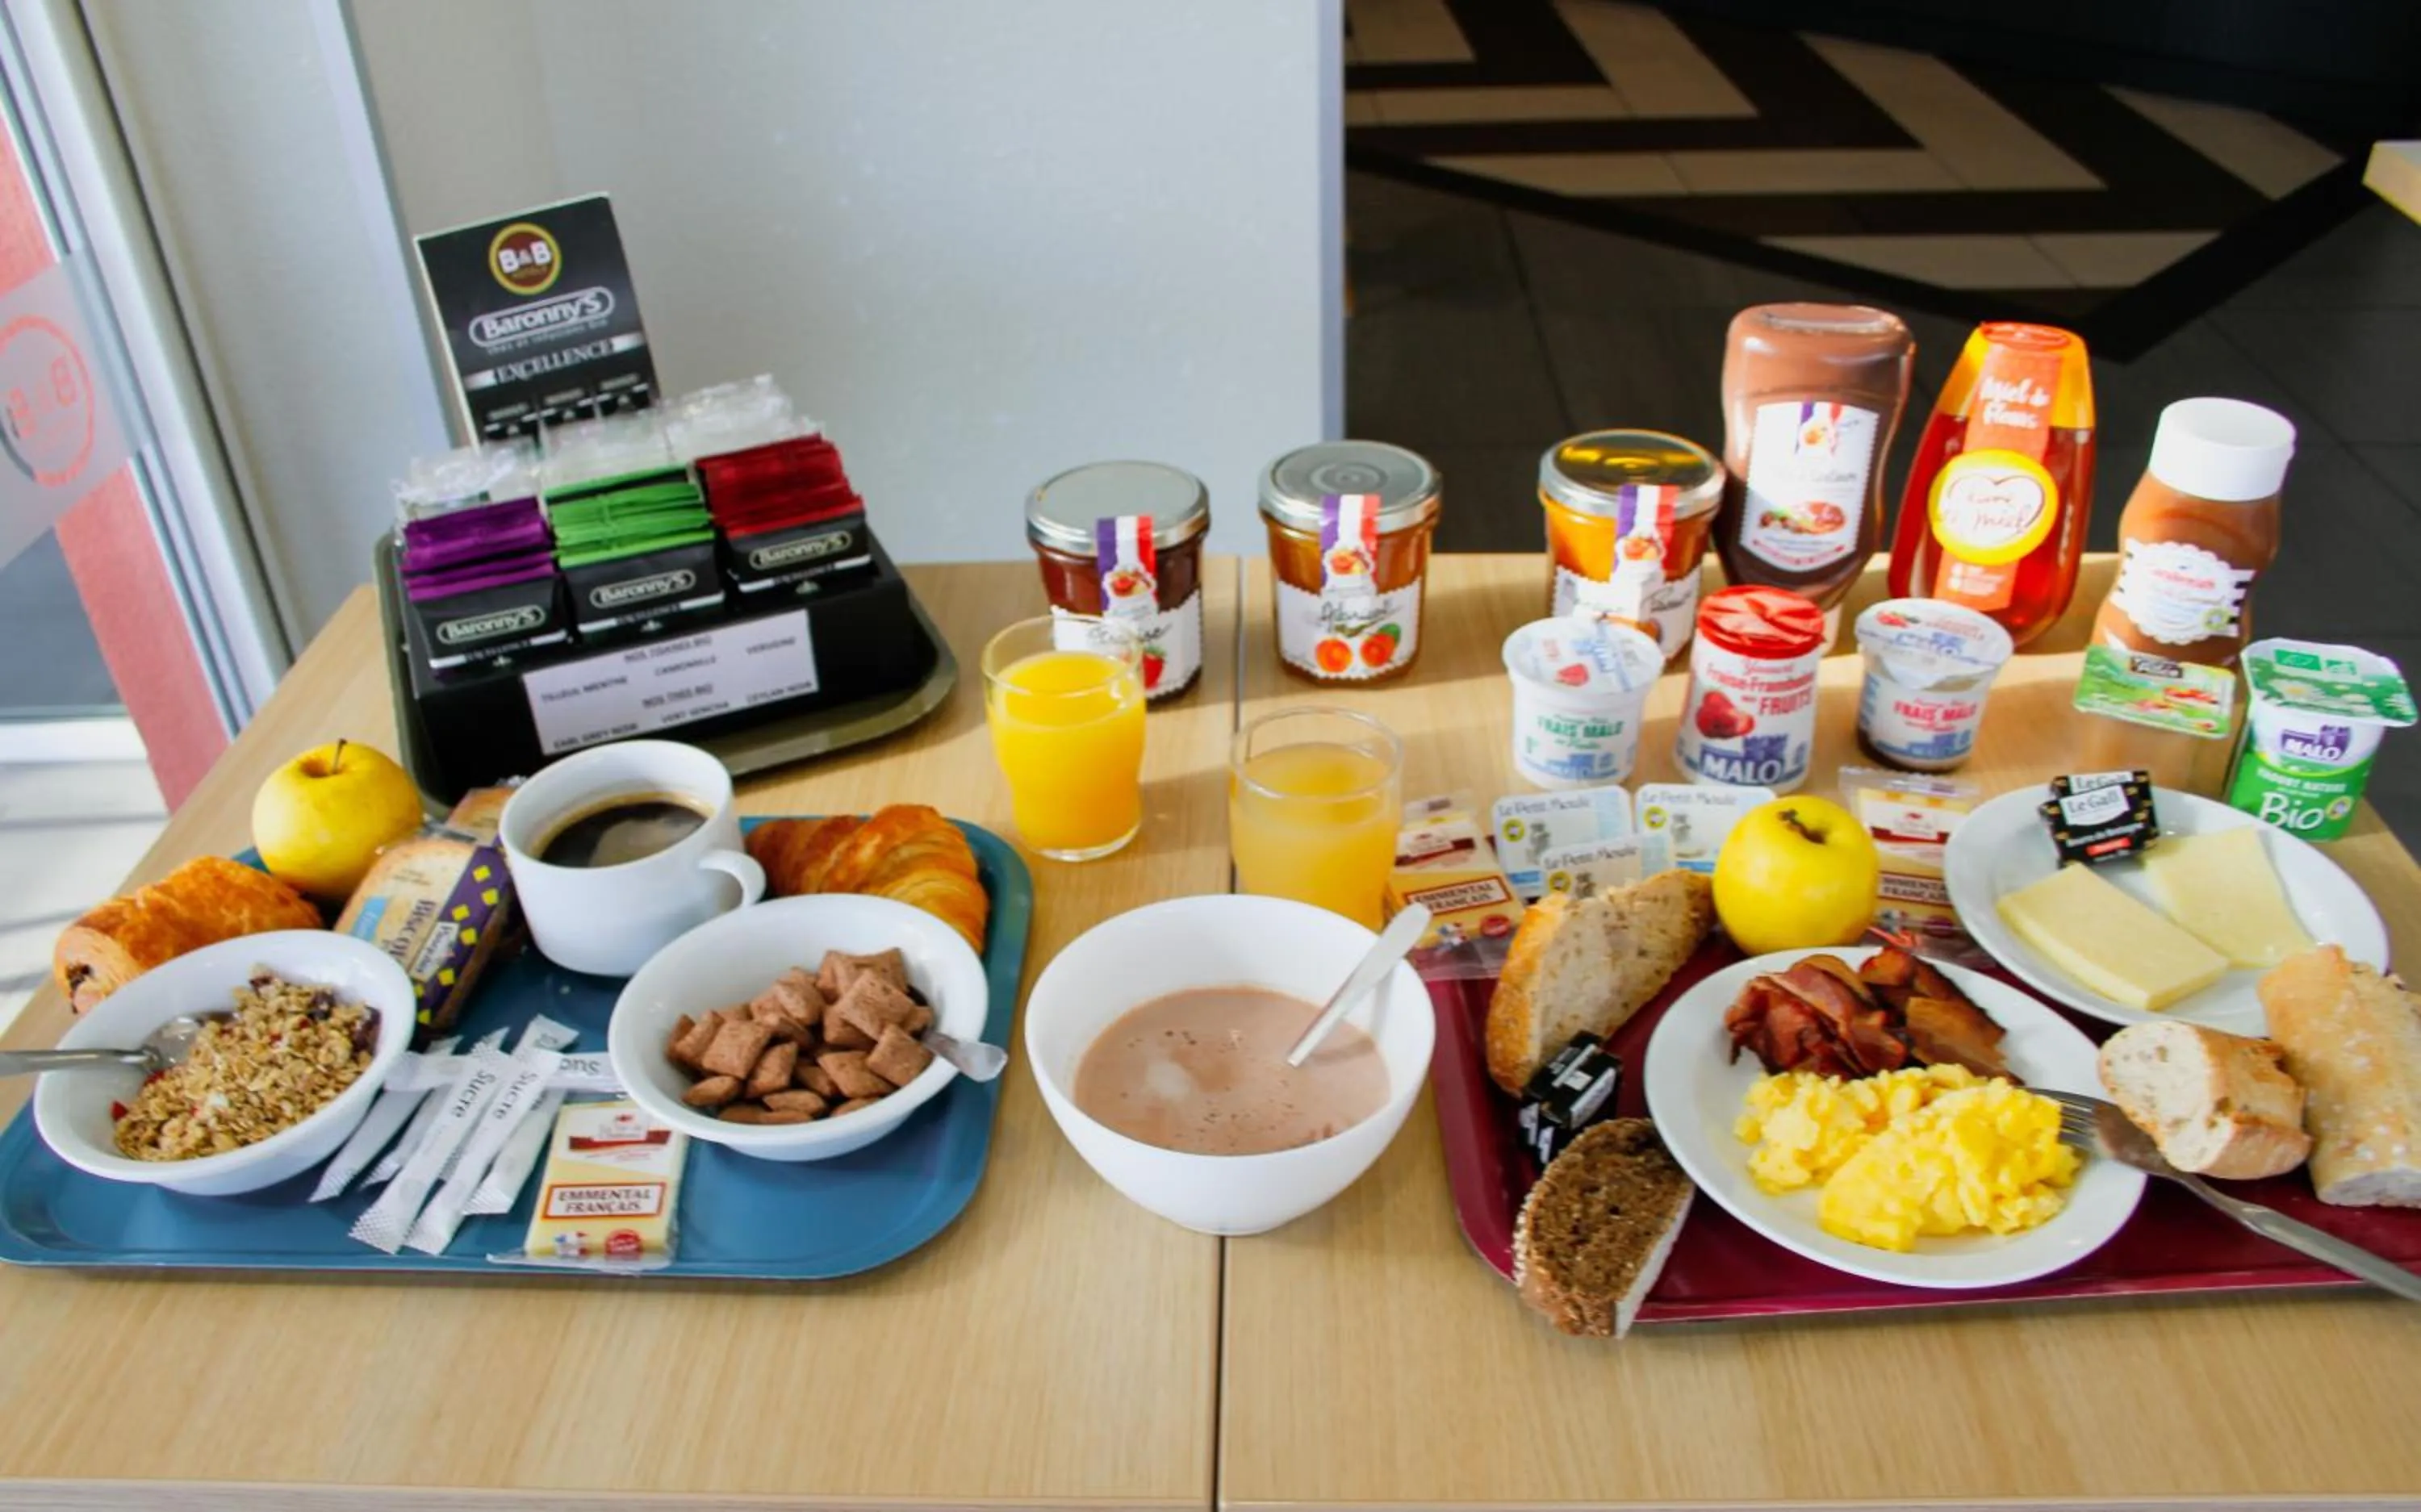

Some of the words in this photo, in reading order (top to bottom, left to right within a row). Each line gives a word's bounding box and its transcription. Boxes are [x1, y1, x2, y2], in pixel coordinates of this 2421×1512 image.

[498, 340, 616, 383] EXCELLENCE
[2285, 739, 2341, 760] MALO
[1702, 754, 1781, 783] MALO
[2260, 790, 2325, 830] Bio
[559, 1057, 602, 1076] Suc
[452, 1071, 496, 1118] Sucre
[494, 1071, 540, 1119] Sucre
[557, 1188, 651, 1202] EMMENTAL
[565, 1200, 642, 1213] FRANÇAIS
